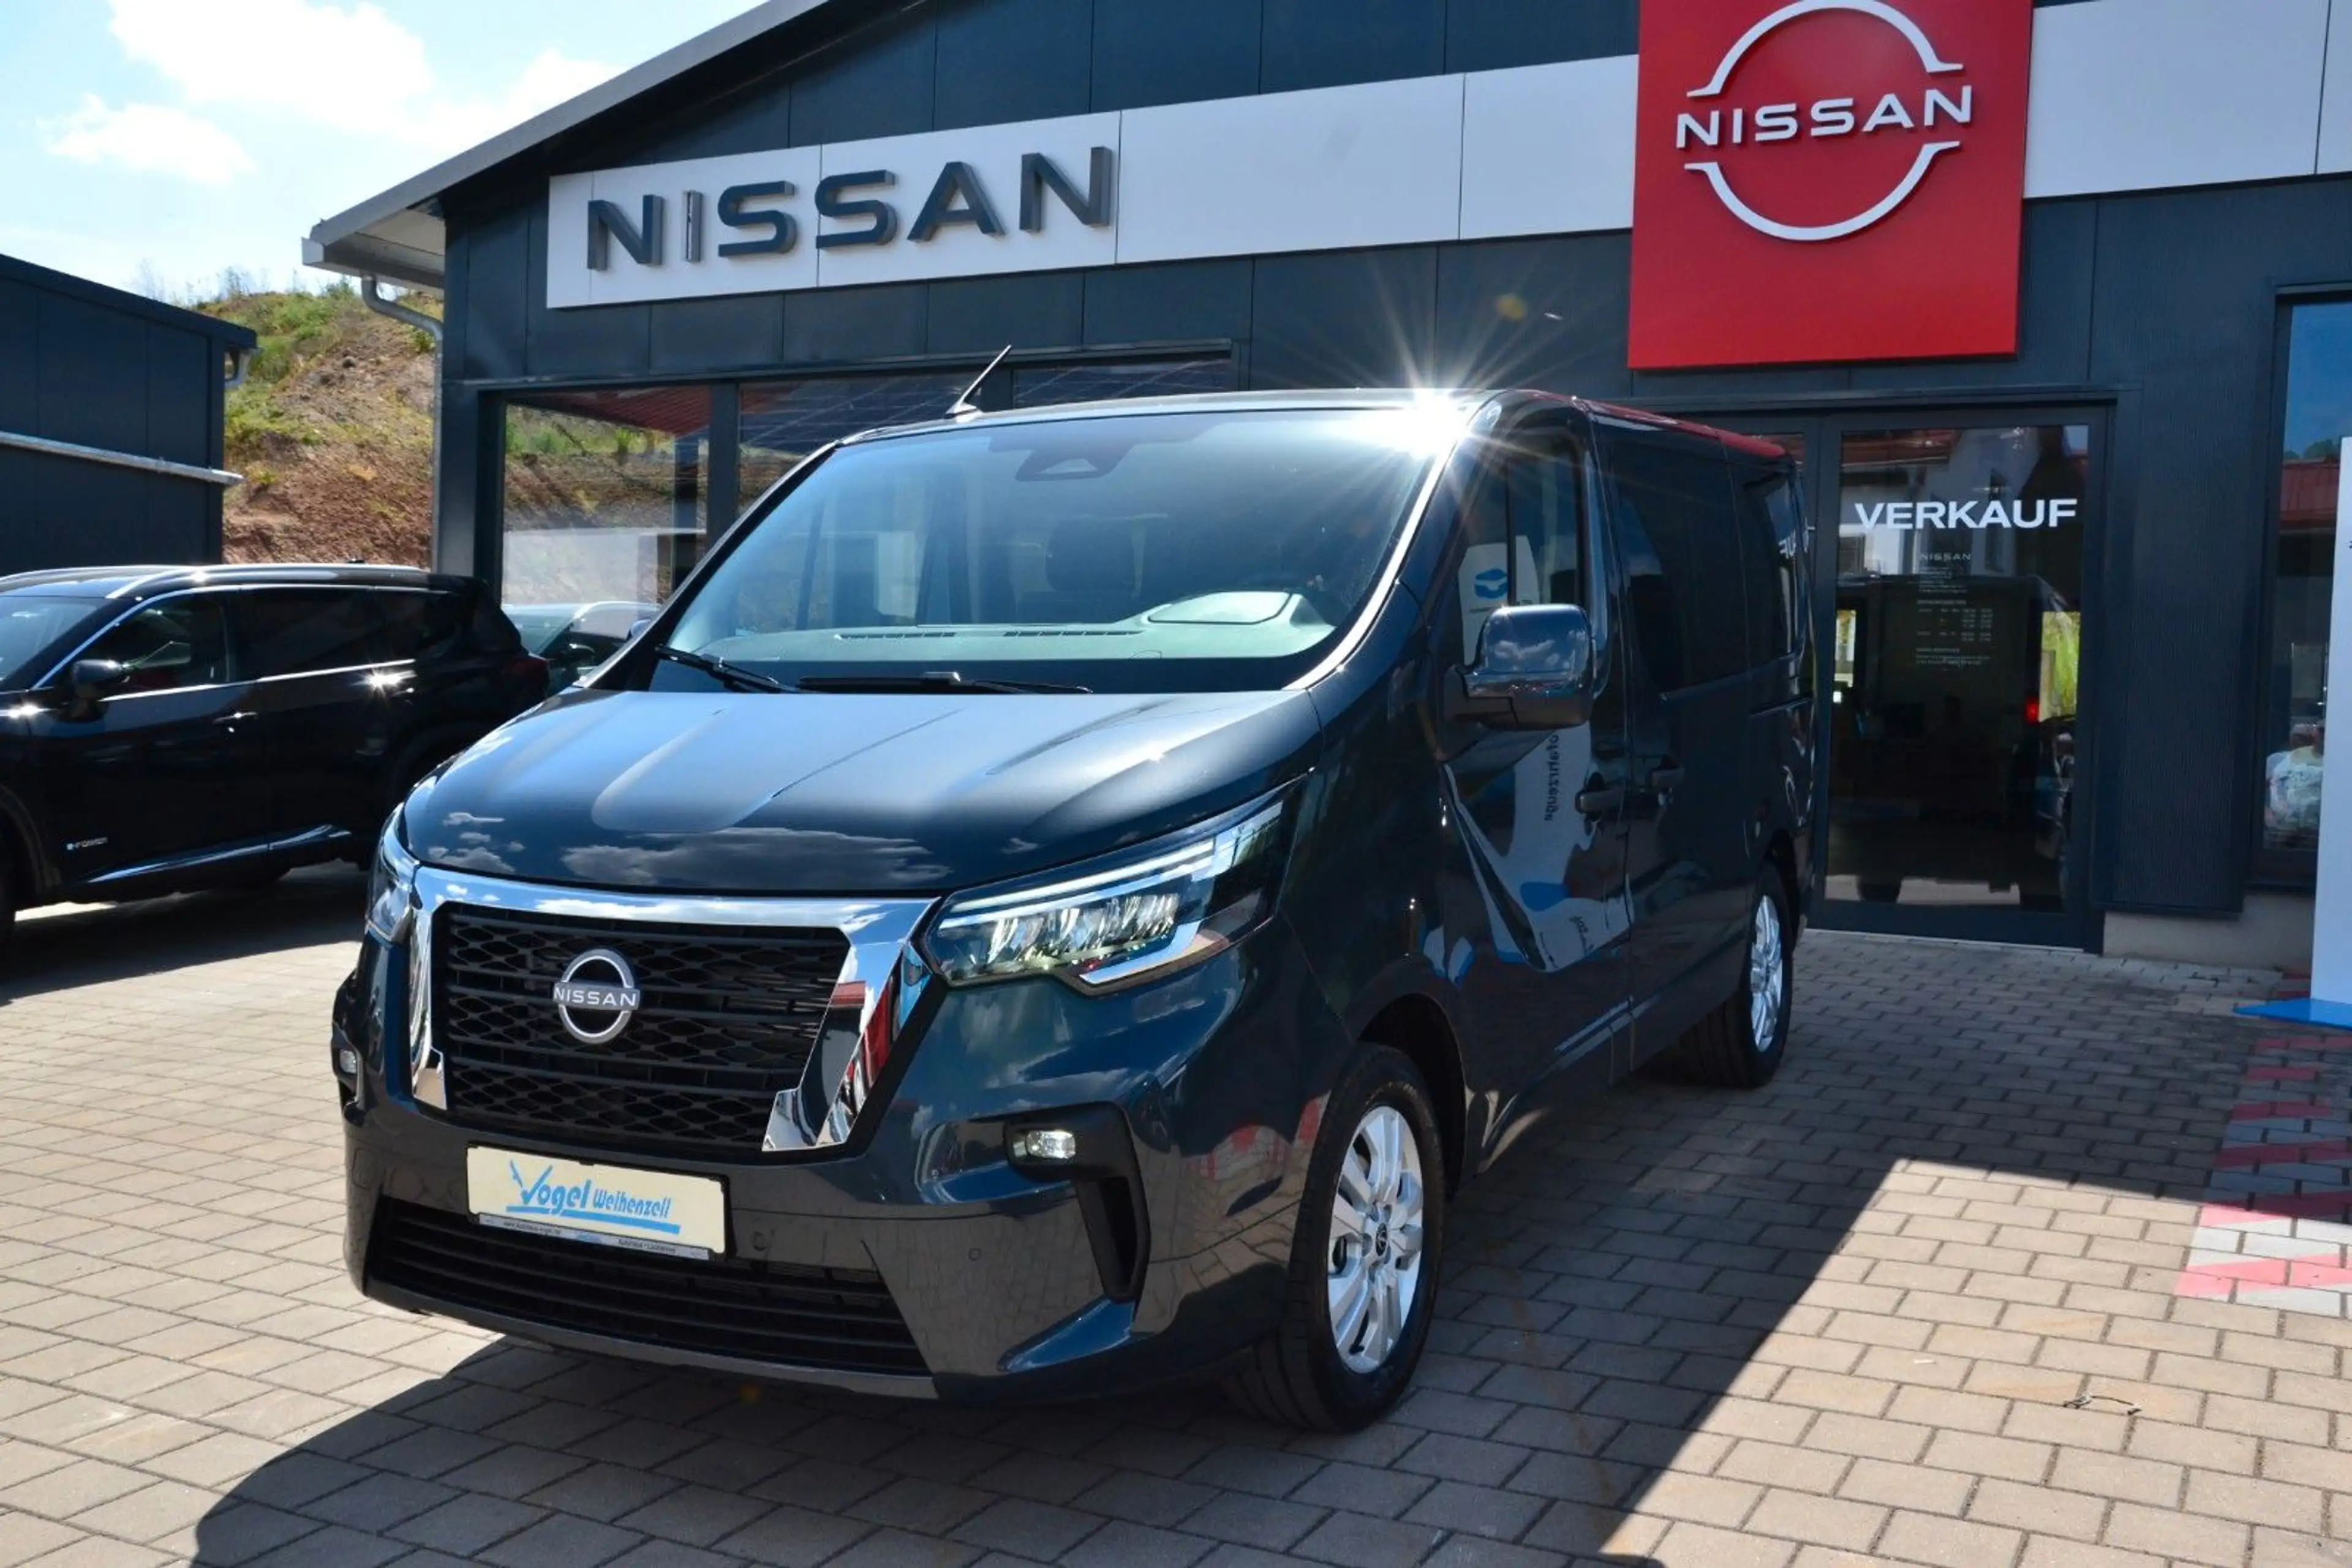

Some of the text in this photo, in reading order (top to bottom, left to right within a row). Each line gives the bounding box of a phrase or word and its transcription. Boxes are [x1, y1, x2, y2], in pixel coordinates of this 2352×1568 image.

[1676, 85, 1972, 148] NISSAN
[587, 146, 1112, 271] NISSAN
[1855, 499, 2078, 529] VERKAUF
[1919, 552, 1972, 562] NISSAN
[554, 987, 636, 1006] NISSAN
[510, 1160, 671, 1219] Vogel Weihenzell
